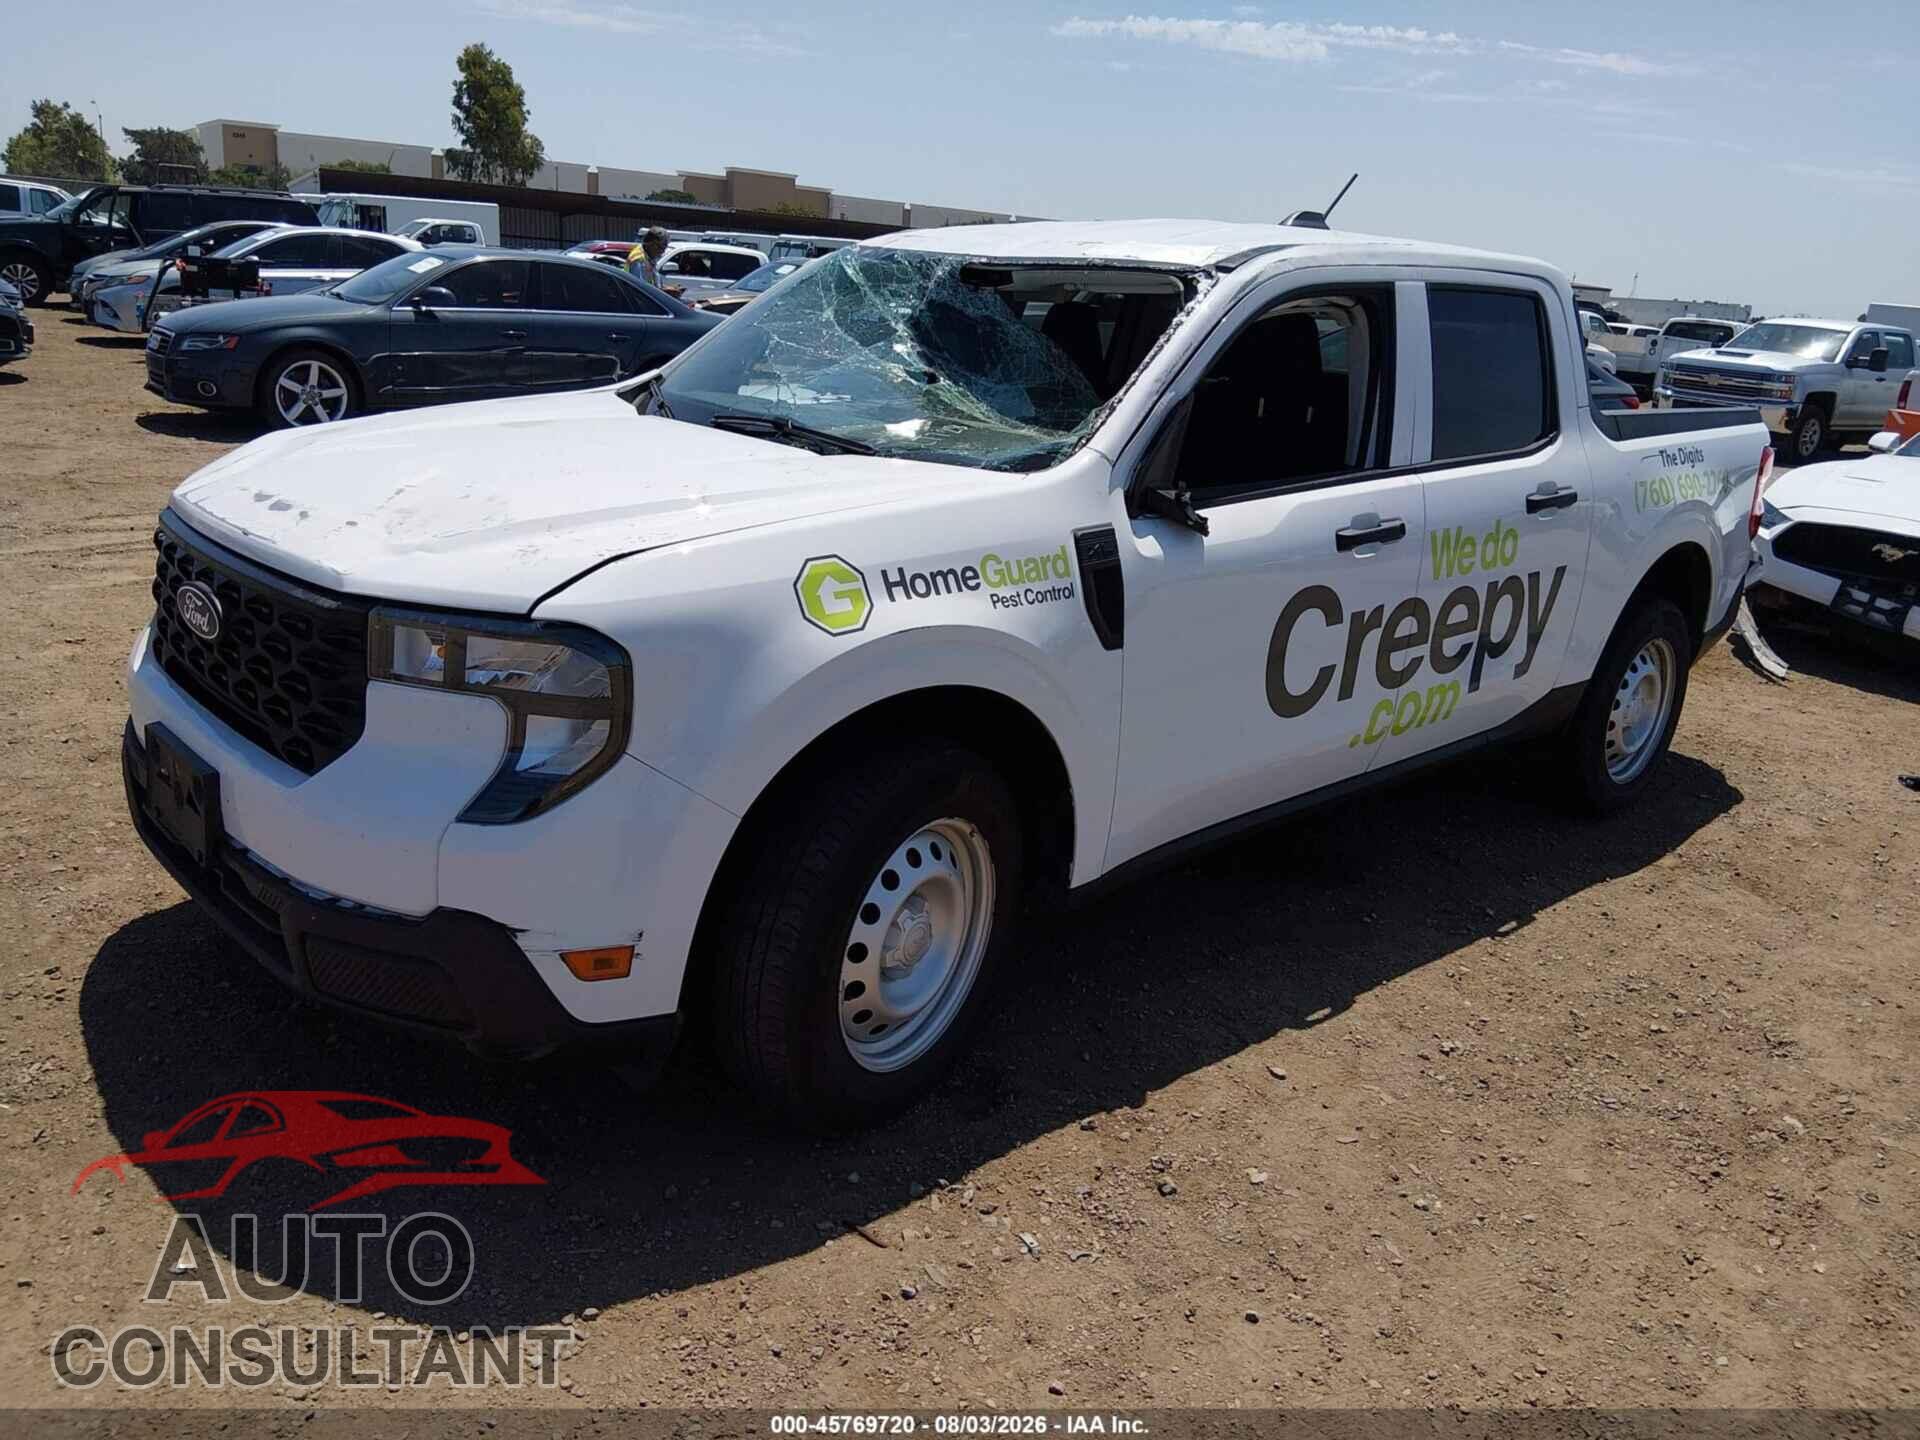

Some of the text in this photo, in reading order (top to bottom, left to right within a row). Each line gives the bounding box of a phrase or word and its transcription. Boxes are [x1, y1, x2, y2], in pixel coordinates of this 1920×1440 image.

[1658, 446, 1704, 468] The Digits
[1634, 474, 1676, 514] (760)
[880, 544, 1072, 603] HomeGuard
[1430, 519, 1519, 581] We do
[184, 591, 211, 633] Ford
[990, 582, 1075, 611] Pest Control
[1265, 565, 1567, 719] Creepy
[1348, 680, 1462, 748] .com
